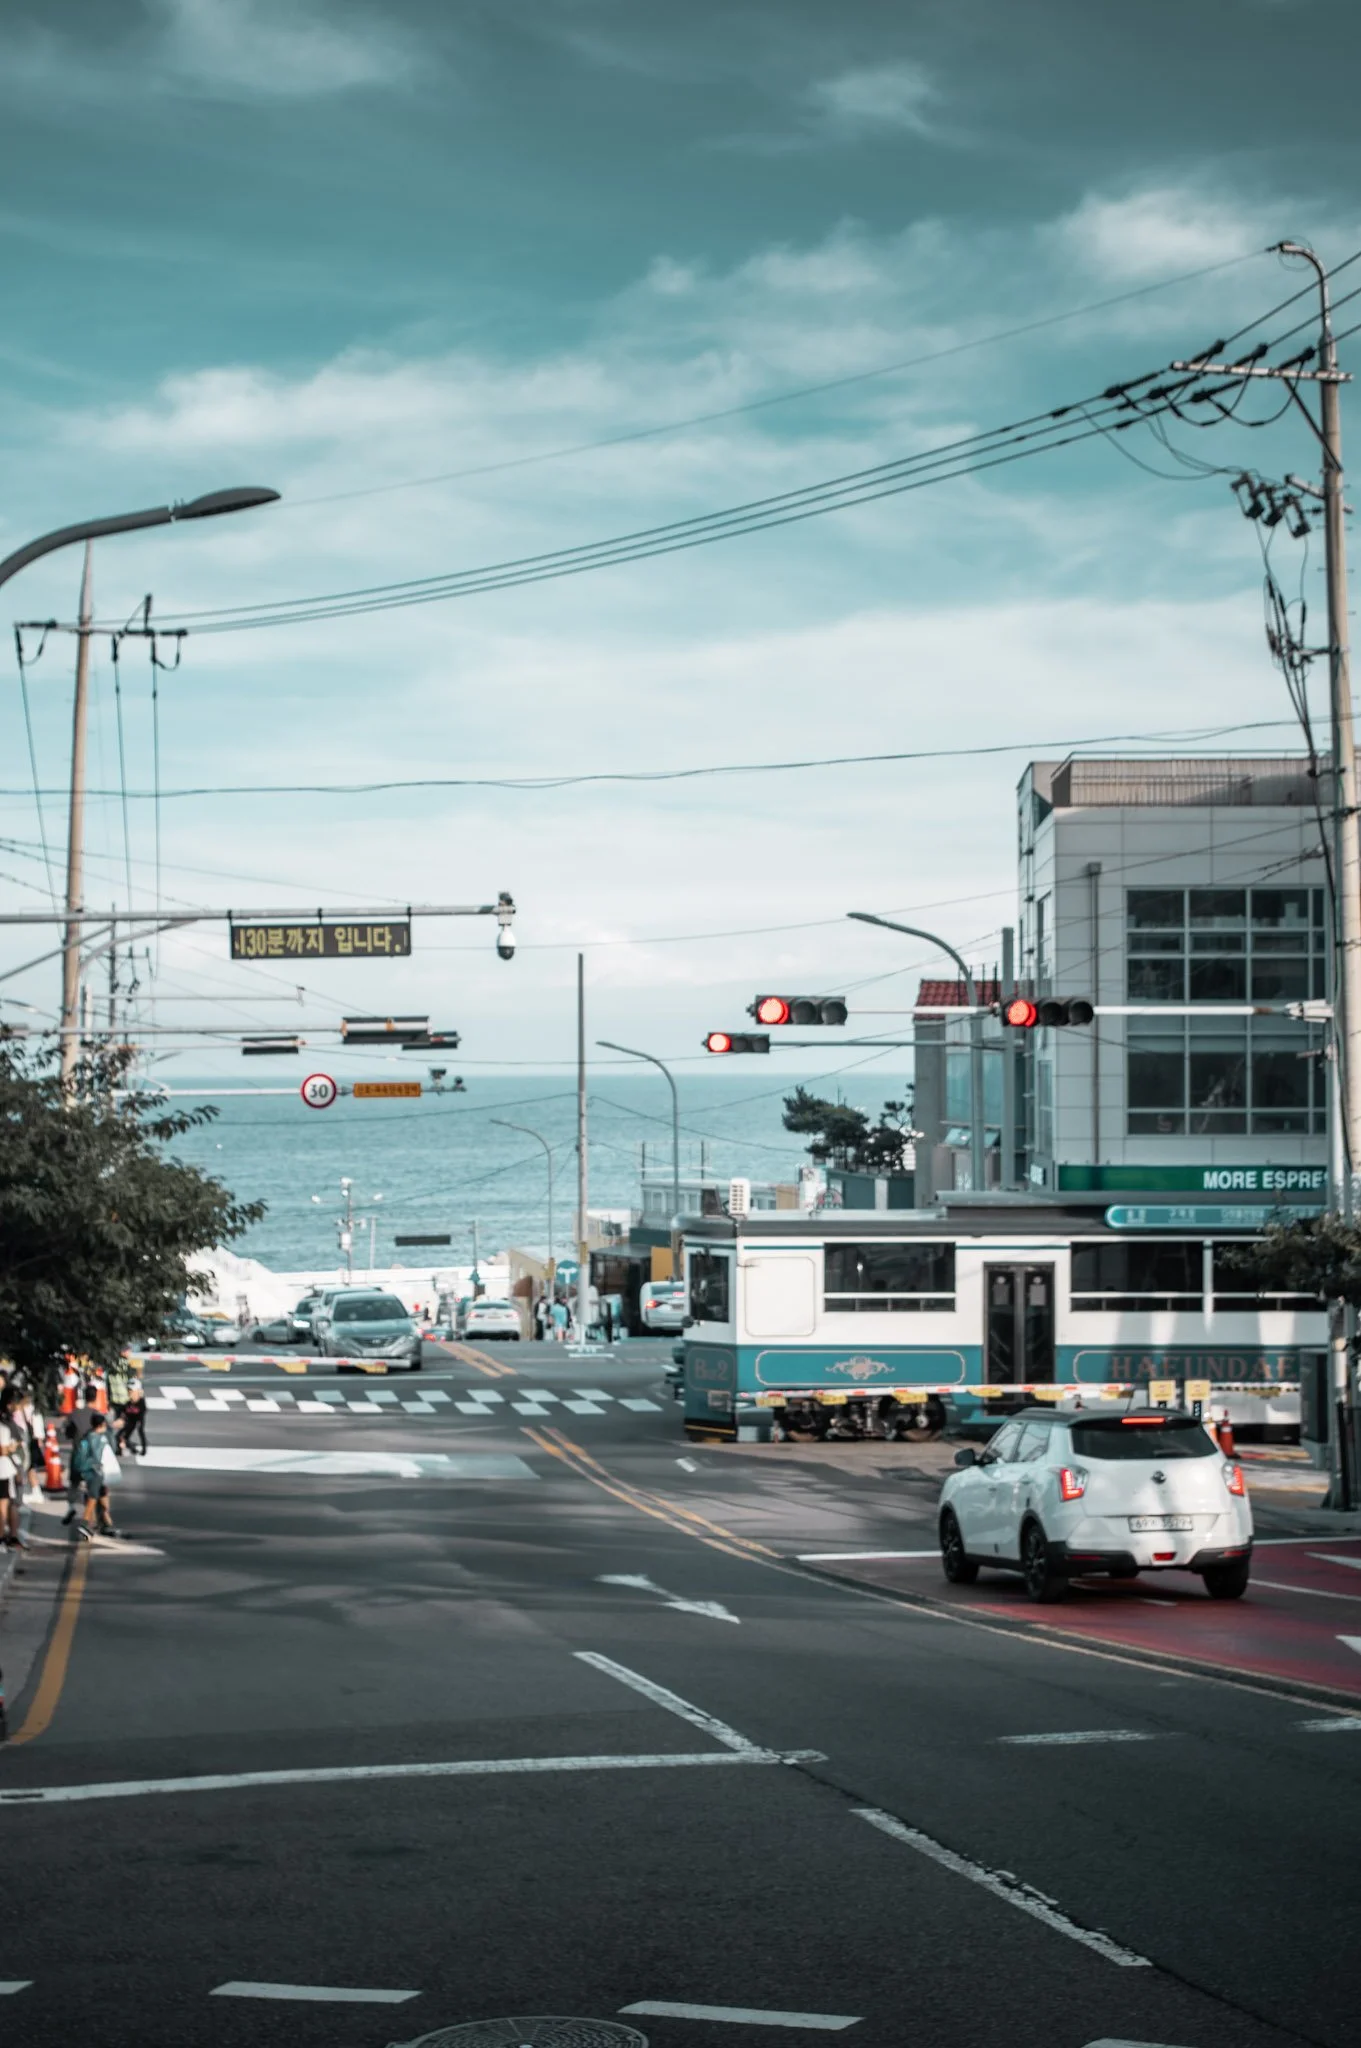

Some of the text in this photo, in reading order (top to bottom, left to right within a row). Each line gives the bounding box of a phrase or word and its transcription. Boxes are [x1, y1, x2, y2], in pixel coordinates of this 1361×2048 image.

[309, 1082, 329, 1100] 30
[1203, 1171, 1258, 1190] MORE
[1111, 1355, 1297, 1380] HAEUNDAE
